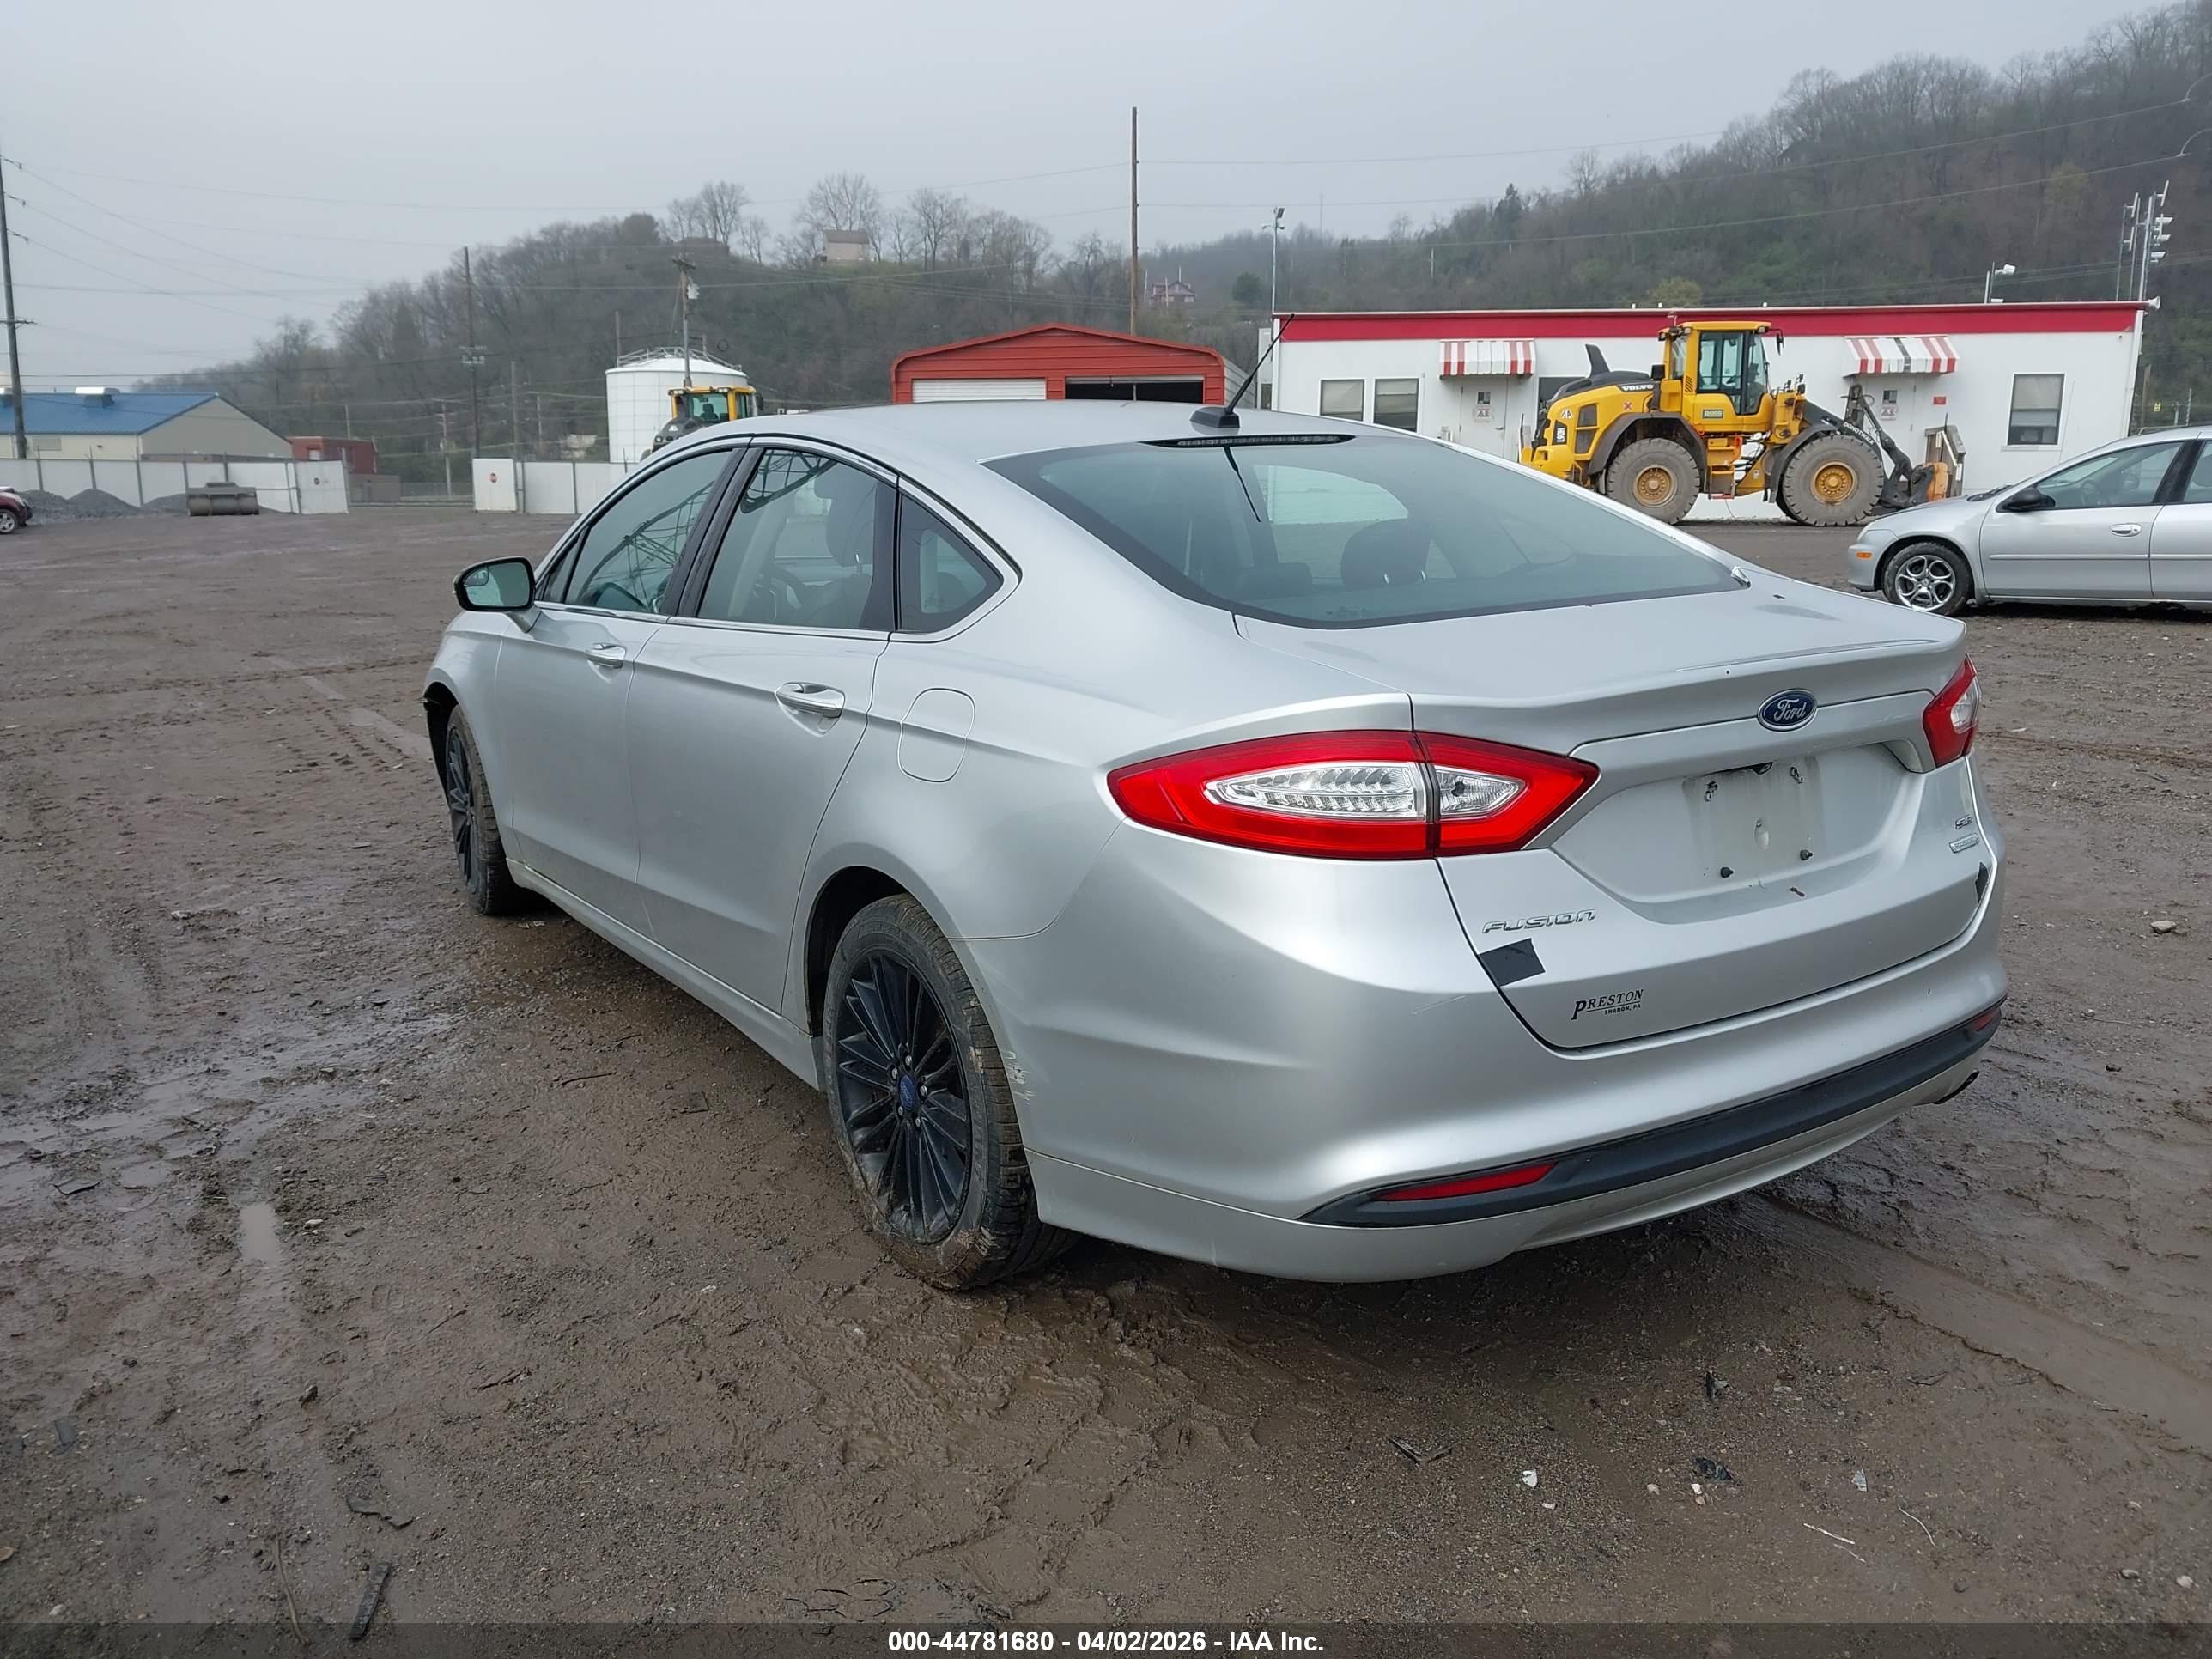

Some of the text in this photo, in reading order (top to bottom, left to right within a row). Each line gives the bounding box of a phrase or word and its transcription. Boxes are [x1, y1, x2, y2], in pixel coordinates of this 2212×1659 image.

[1773, 698, 1807, 721] Ford
[1481, 908, 1598, 933] FUSION
[1571, 988, 1644, 1020] PRESTON
[1604, 1006, 1632, 1015] SHARON,
